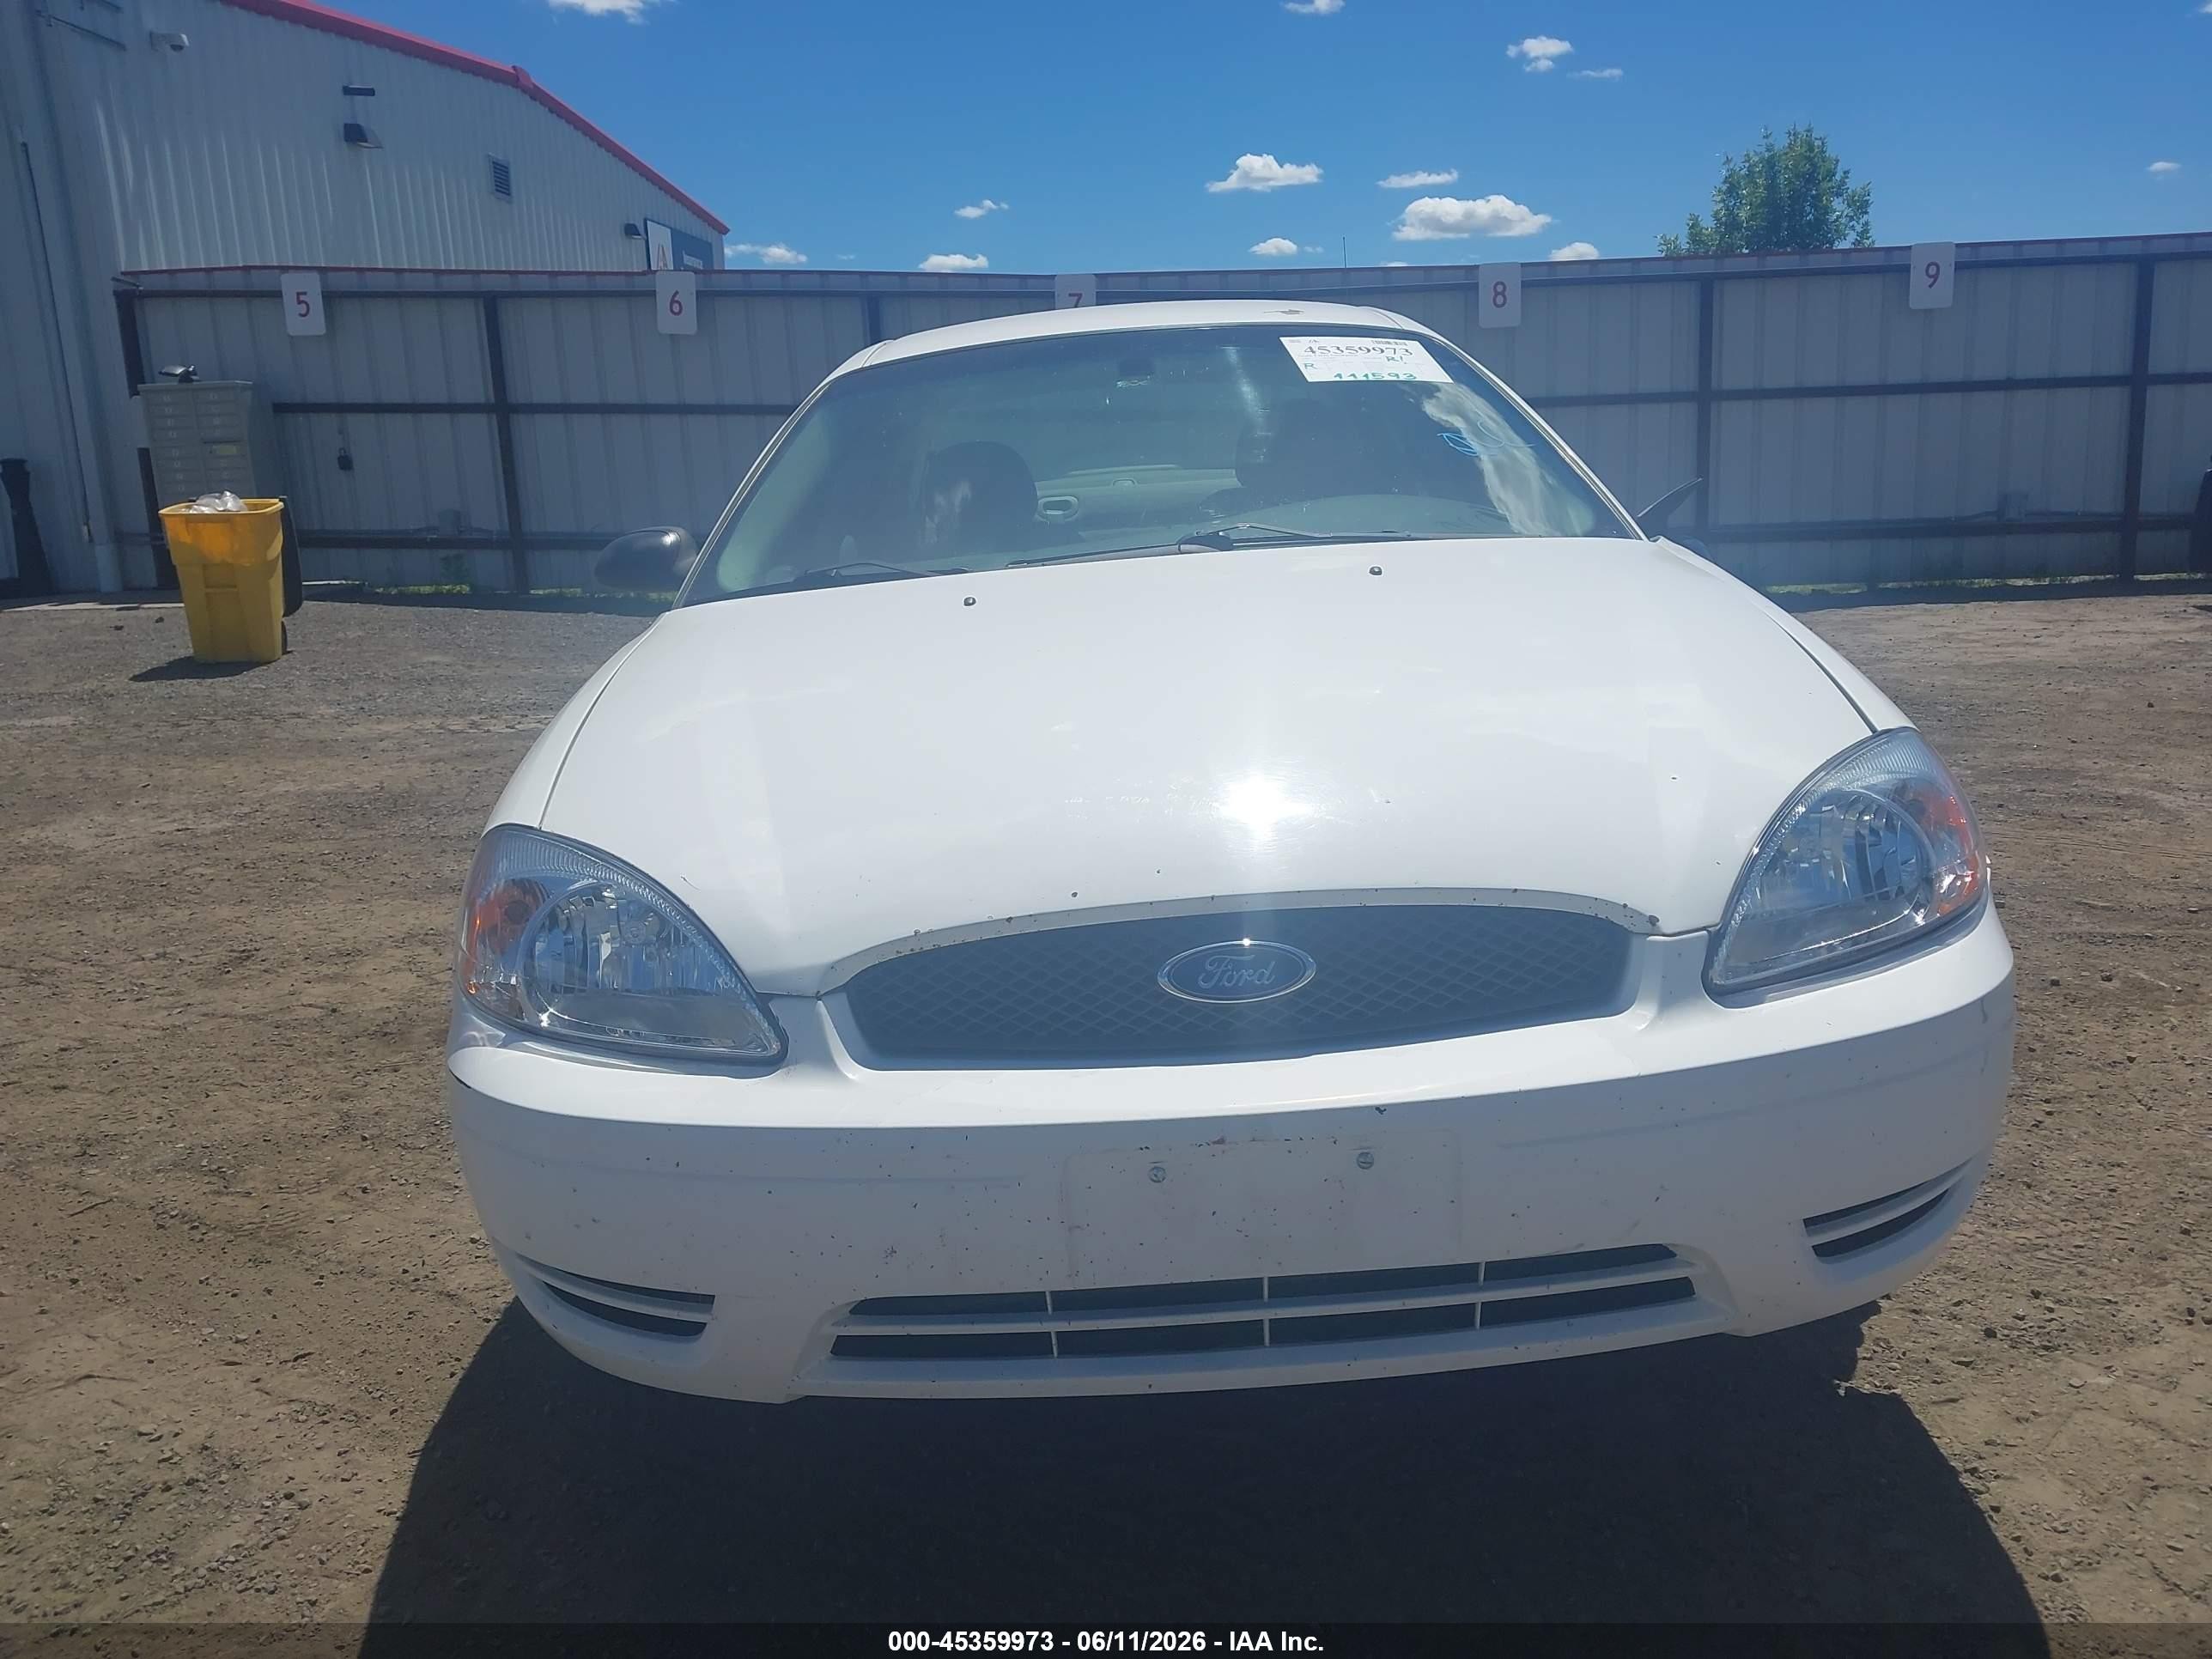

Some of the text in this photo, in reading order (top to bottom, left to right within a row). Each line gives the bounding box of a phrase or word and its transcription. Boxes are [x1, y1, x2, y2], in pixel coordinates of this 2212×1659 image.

[1925, 261, 1941, 289] 9
[295, 291, 310, 318] 5
[670, 289, 684, 316] 6
[1492, 282, 1507, 308] 8
[1304, 345, 1413, 356] 45359973
[1197, 954, 1276, 989] Ford
